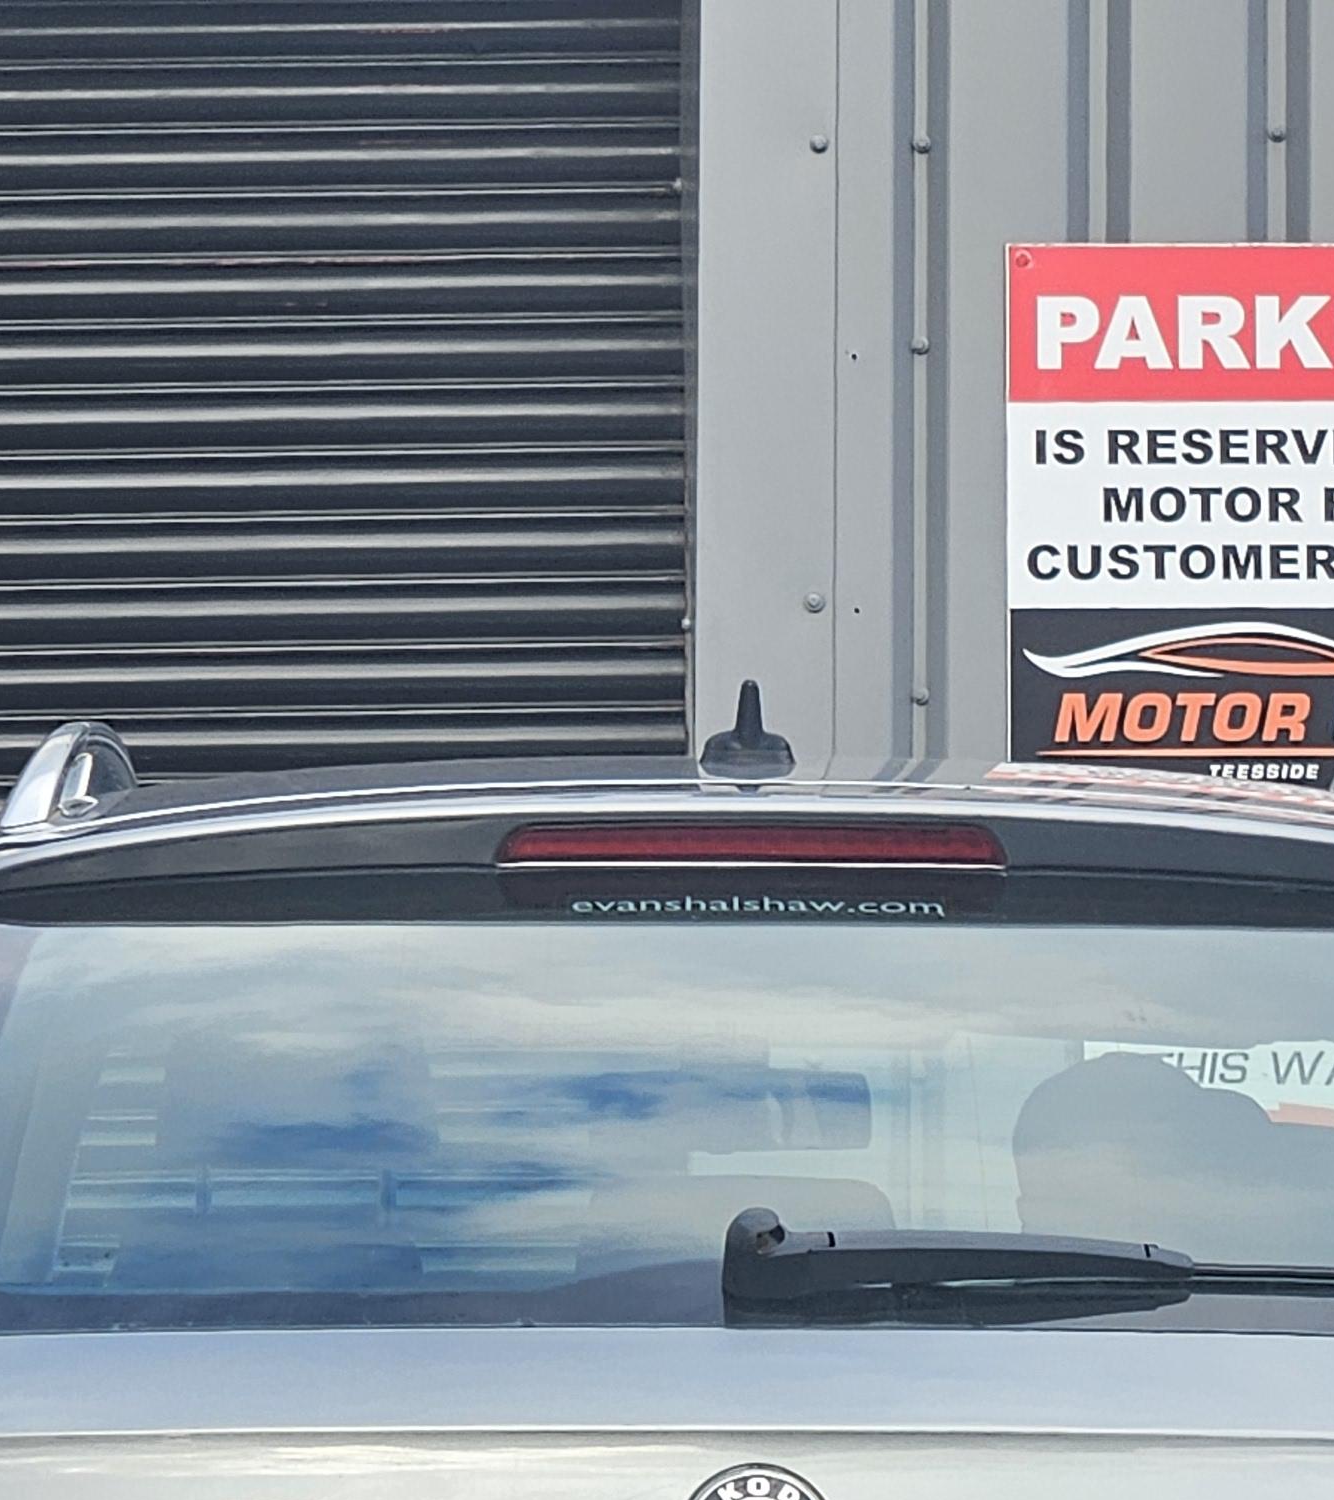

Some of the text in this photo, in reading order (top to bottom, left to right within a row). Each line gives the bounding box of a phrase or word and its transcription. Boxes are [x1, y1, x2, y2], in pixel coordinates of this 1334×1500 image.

[1034, 428, 1086, 465] IS
[1102, 486, 1303, 523] MOTOR
[1053, 692, 1313, 743] MOTOR
[1209, 763, 1320, 780] TEESSIDE
[571, 895, 946, 918] evanshalshaw.com
[1165, 1051, 1250, 1086] HIS
